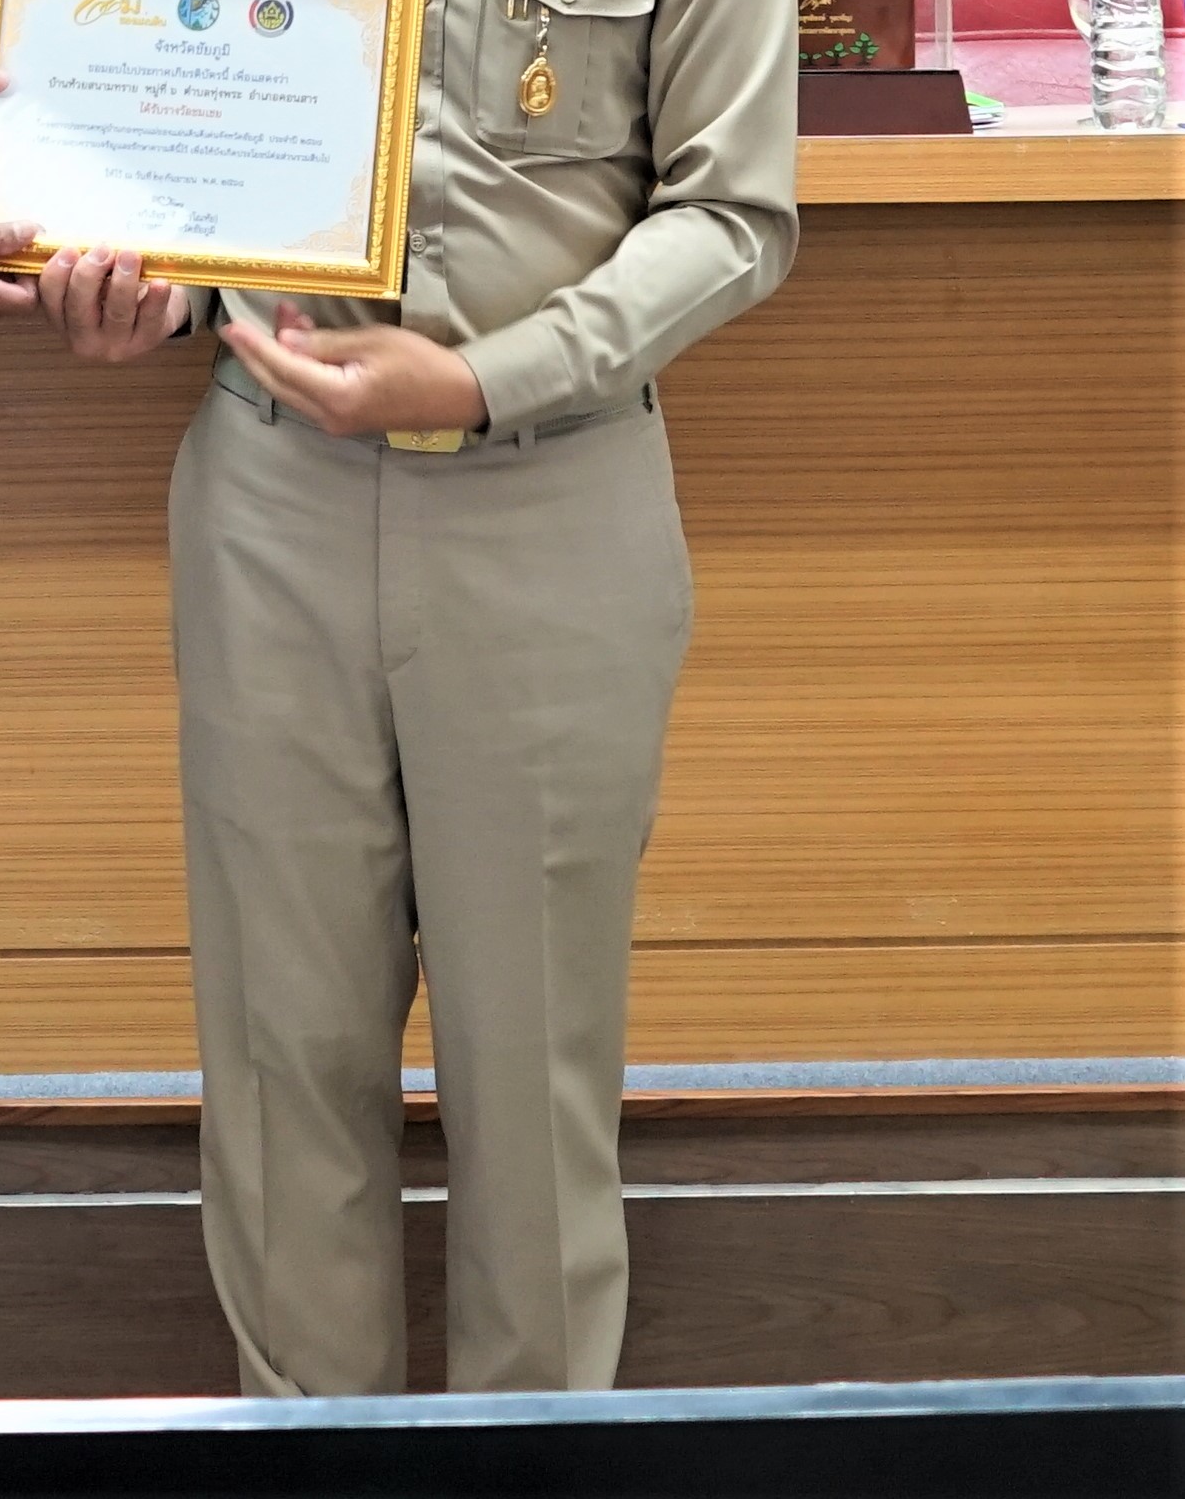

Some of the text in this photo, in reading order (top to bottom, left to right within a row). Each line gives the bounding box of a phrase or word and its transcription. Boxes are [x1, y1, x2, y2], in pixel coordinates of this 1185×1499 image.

[154, 38, 231, 61] จังหวัดชัยภูมิ
